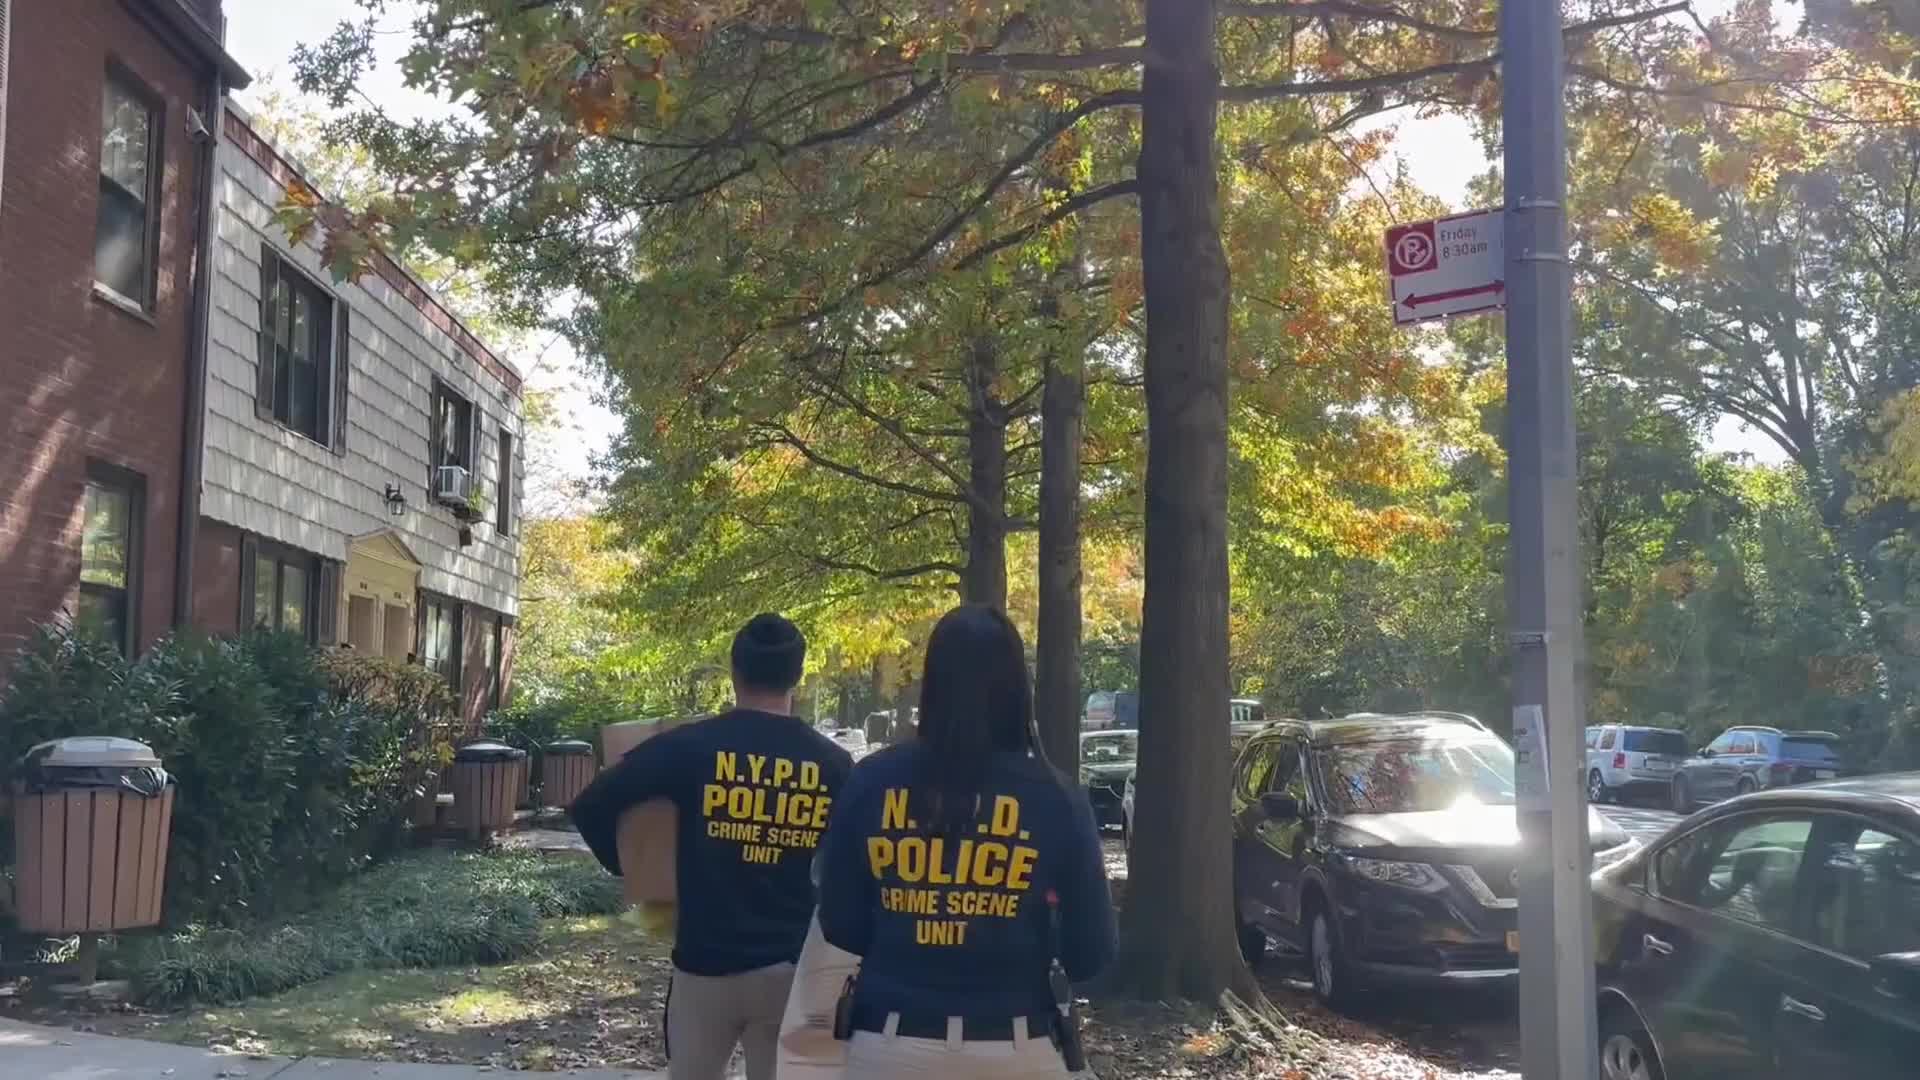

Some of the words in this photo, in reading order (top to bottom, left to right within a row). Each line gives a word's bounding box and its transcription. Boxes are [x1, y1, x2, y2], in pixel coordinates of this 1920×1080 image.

[1440, 227, 1477, 242] Friday
[1442, 243, 1488, 259] 830am
[715, 750, 828, 792] N.Y.P.D.
[703, 783, 833, 828] POLICE
[881, 787, 1031, 840] N..D.
[707, 820, 761, 843] CRIME
[767, 827, 820, 849] SCENE
[743, 844, 783, 865] UNIT
[867, 836, 1039, 890] POLICE
[881, 886, 940, 915] CRIME
[946, 890, 1019, 918] SCENE
[916, 919, 969, 945] UNIT
